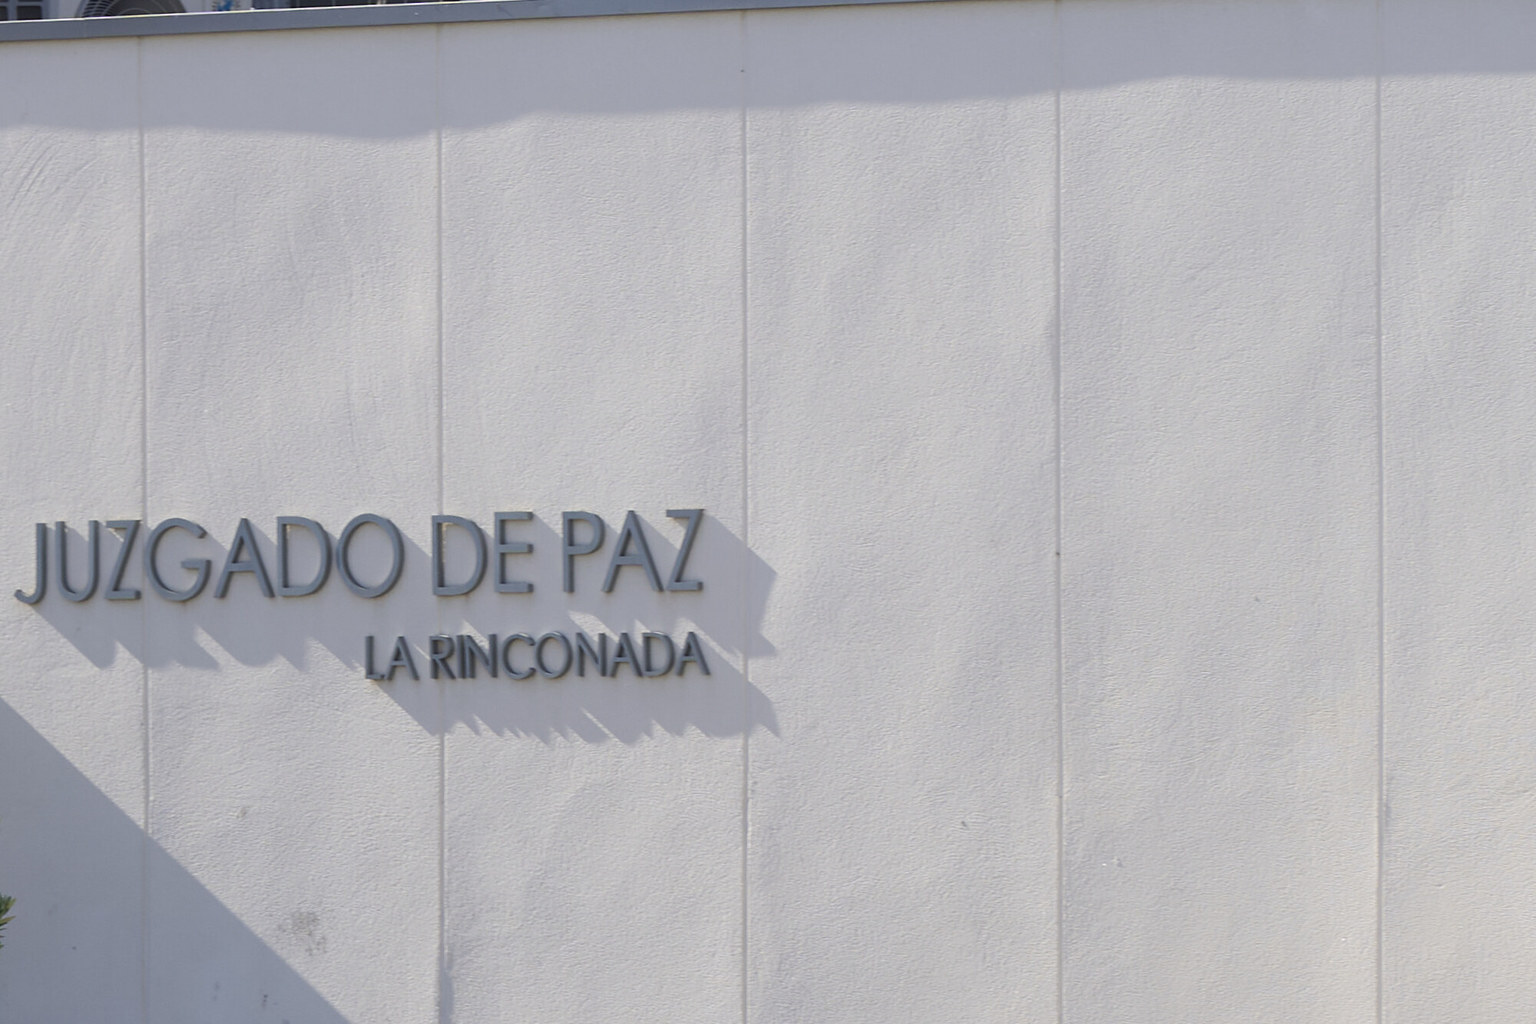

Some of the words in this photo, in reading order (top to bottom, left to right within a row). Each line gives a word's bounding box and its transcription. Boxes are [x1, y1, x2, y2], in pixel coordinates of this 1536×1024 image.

[15, 513, 405, 604] JUZGADO
[432, 511, 534, 596] DE
[562, 508, 704, 593] PAZ
[365, 635, 420, 681] LA
[430, 631, 710, 680] RINCONADA
